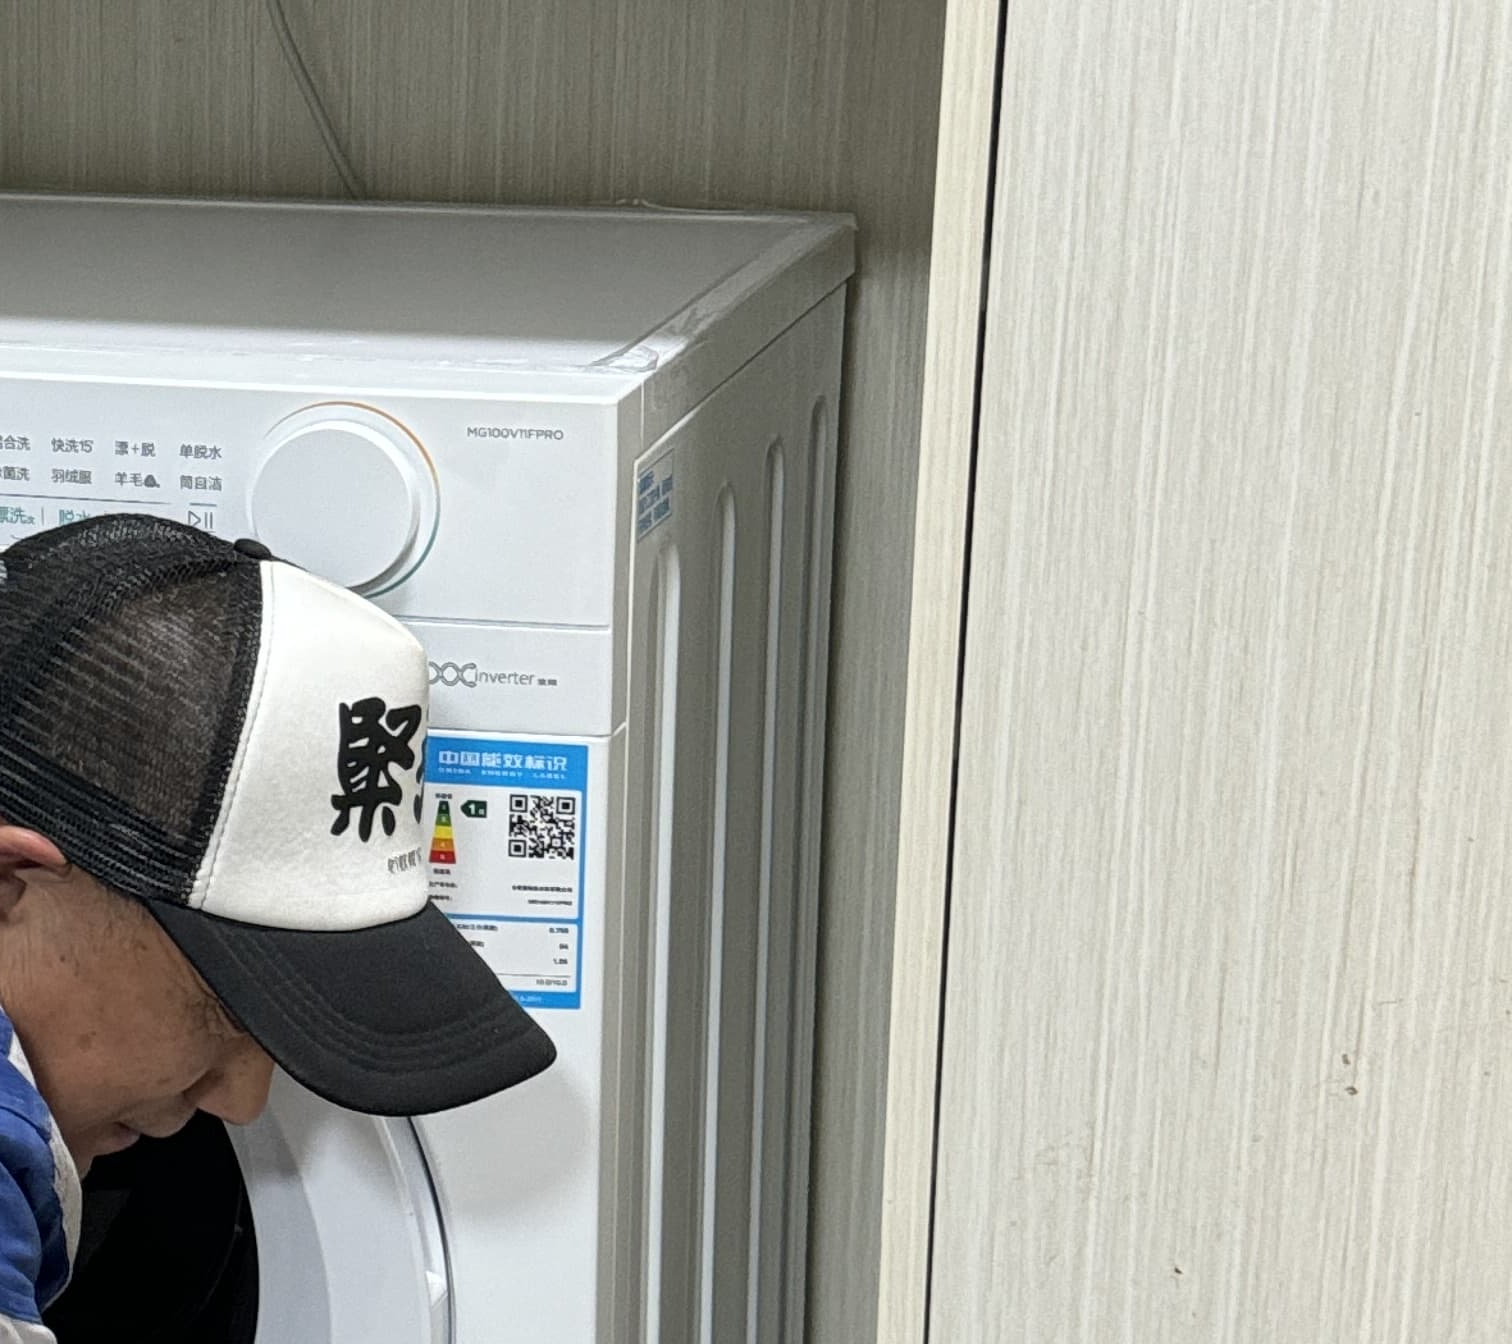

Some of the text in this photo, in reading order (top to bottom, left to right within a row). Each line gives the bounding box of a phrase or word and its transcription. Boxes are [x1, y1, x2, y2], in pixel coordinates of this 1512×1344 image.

[467, 426, 564, 441] MG100V11FPRO
[179, 443, 223, 460] 单脱水
[51, 468, 93, 485] 羽绒服
[114, 472, 143, 488] 羊毛
[438, 750, 568, 772] 中国能效标识
